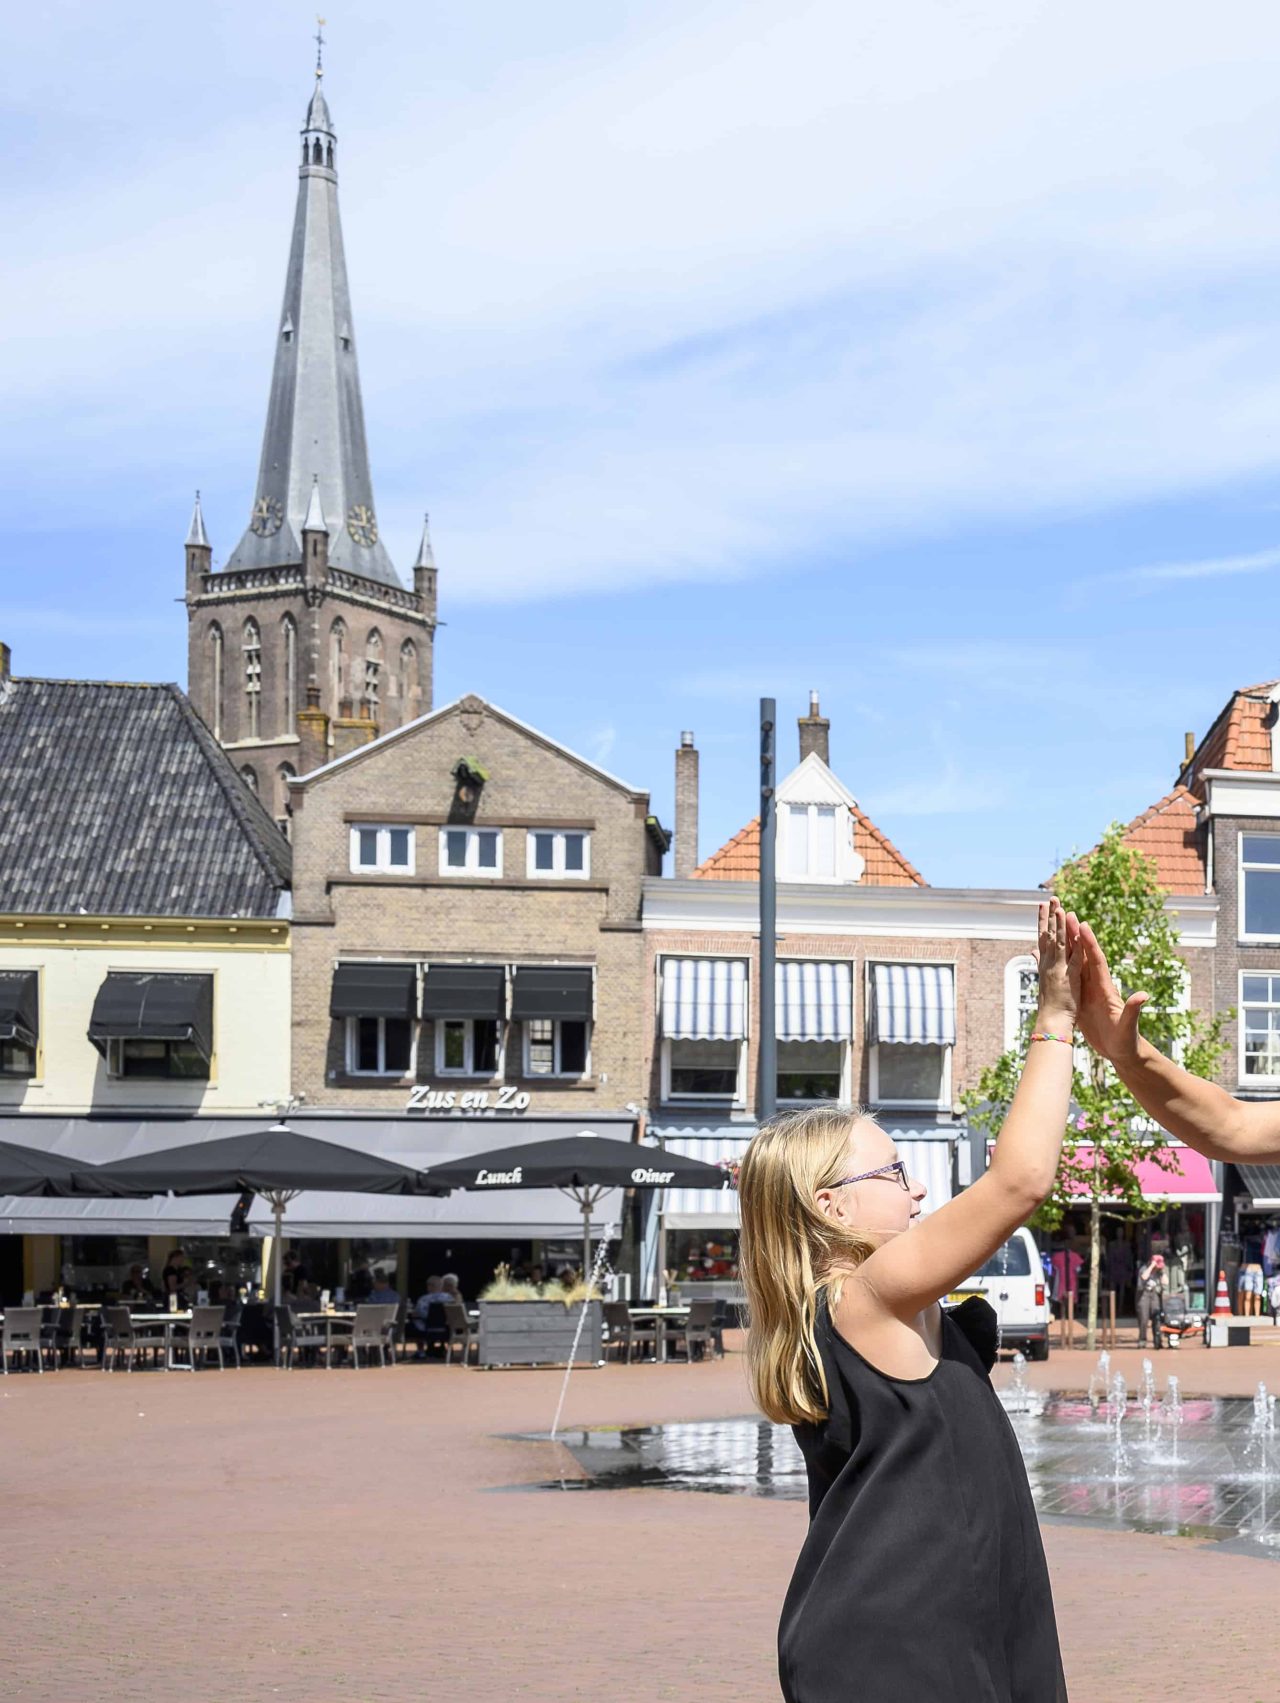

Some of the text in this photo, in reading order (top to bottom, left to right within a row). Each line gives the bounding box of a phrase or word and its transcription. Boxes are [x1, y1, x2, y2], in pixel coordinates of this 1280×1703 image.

[406, 1085, 530, 1109] Zus en Zo
[475, 1167, 522, 1185] Lunch
[631, 1168, 675, 1184] Diner
